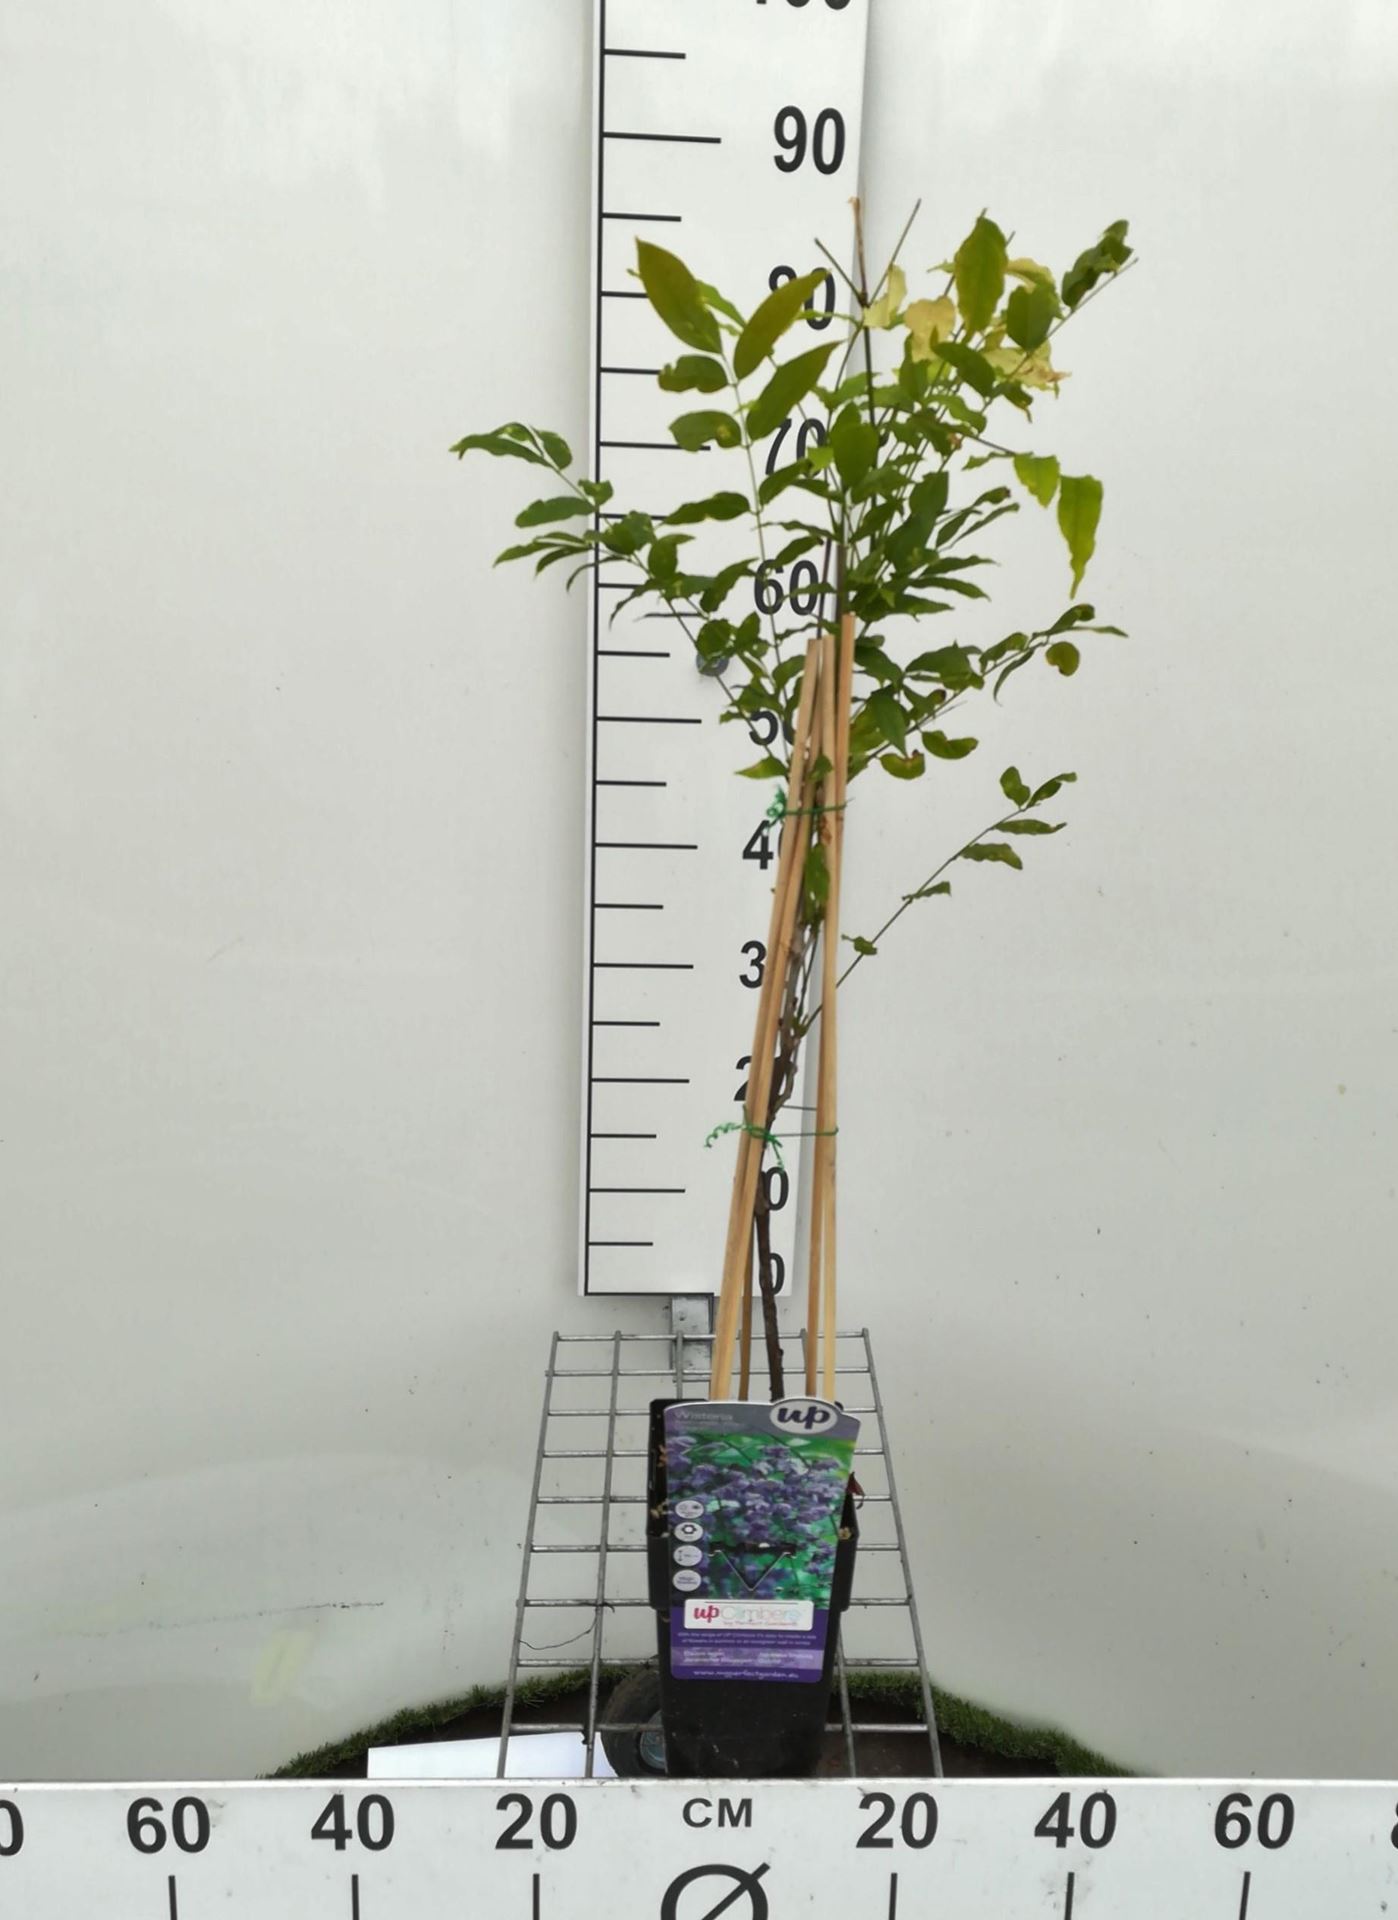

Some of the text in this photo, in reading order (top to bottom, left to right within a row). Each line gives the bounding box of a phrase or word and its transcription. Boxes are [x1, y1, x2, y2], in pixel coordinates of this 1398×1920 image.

[774, 105, 846, 175] 90
[754, 559, 819, 615] 60
[742, 819, 785, 870] 4
[739, 940, 767, 989] 3
[763, 1166, 789, 1211] 0
[776, 1406, 831, 1430] up
[693, 1604, 719, 1623] up
[0, 1790, 1295, 1857] 0 60 40 20 CM 20 40 60
